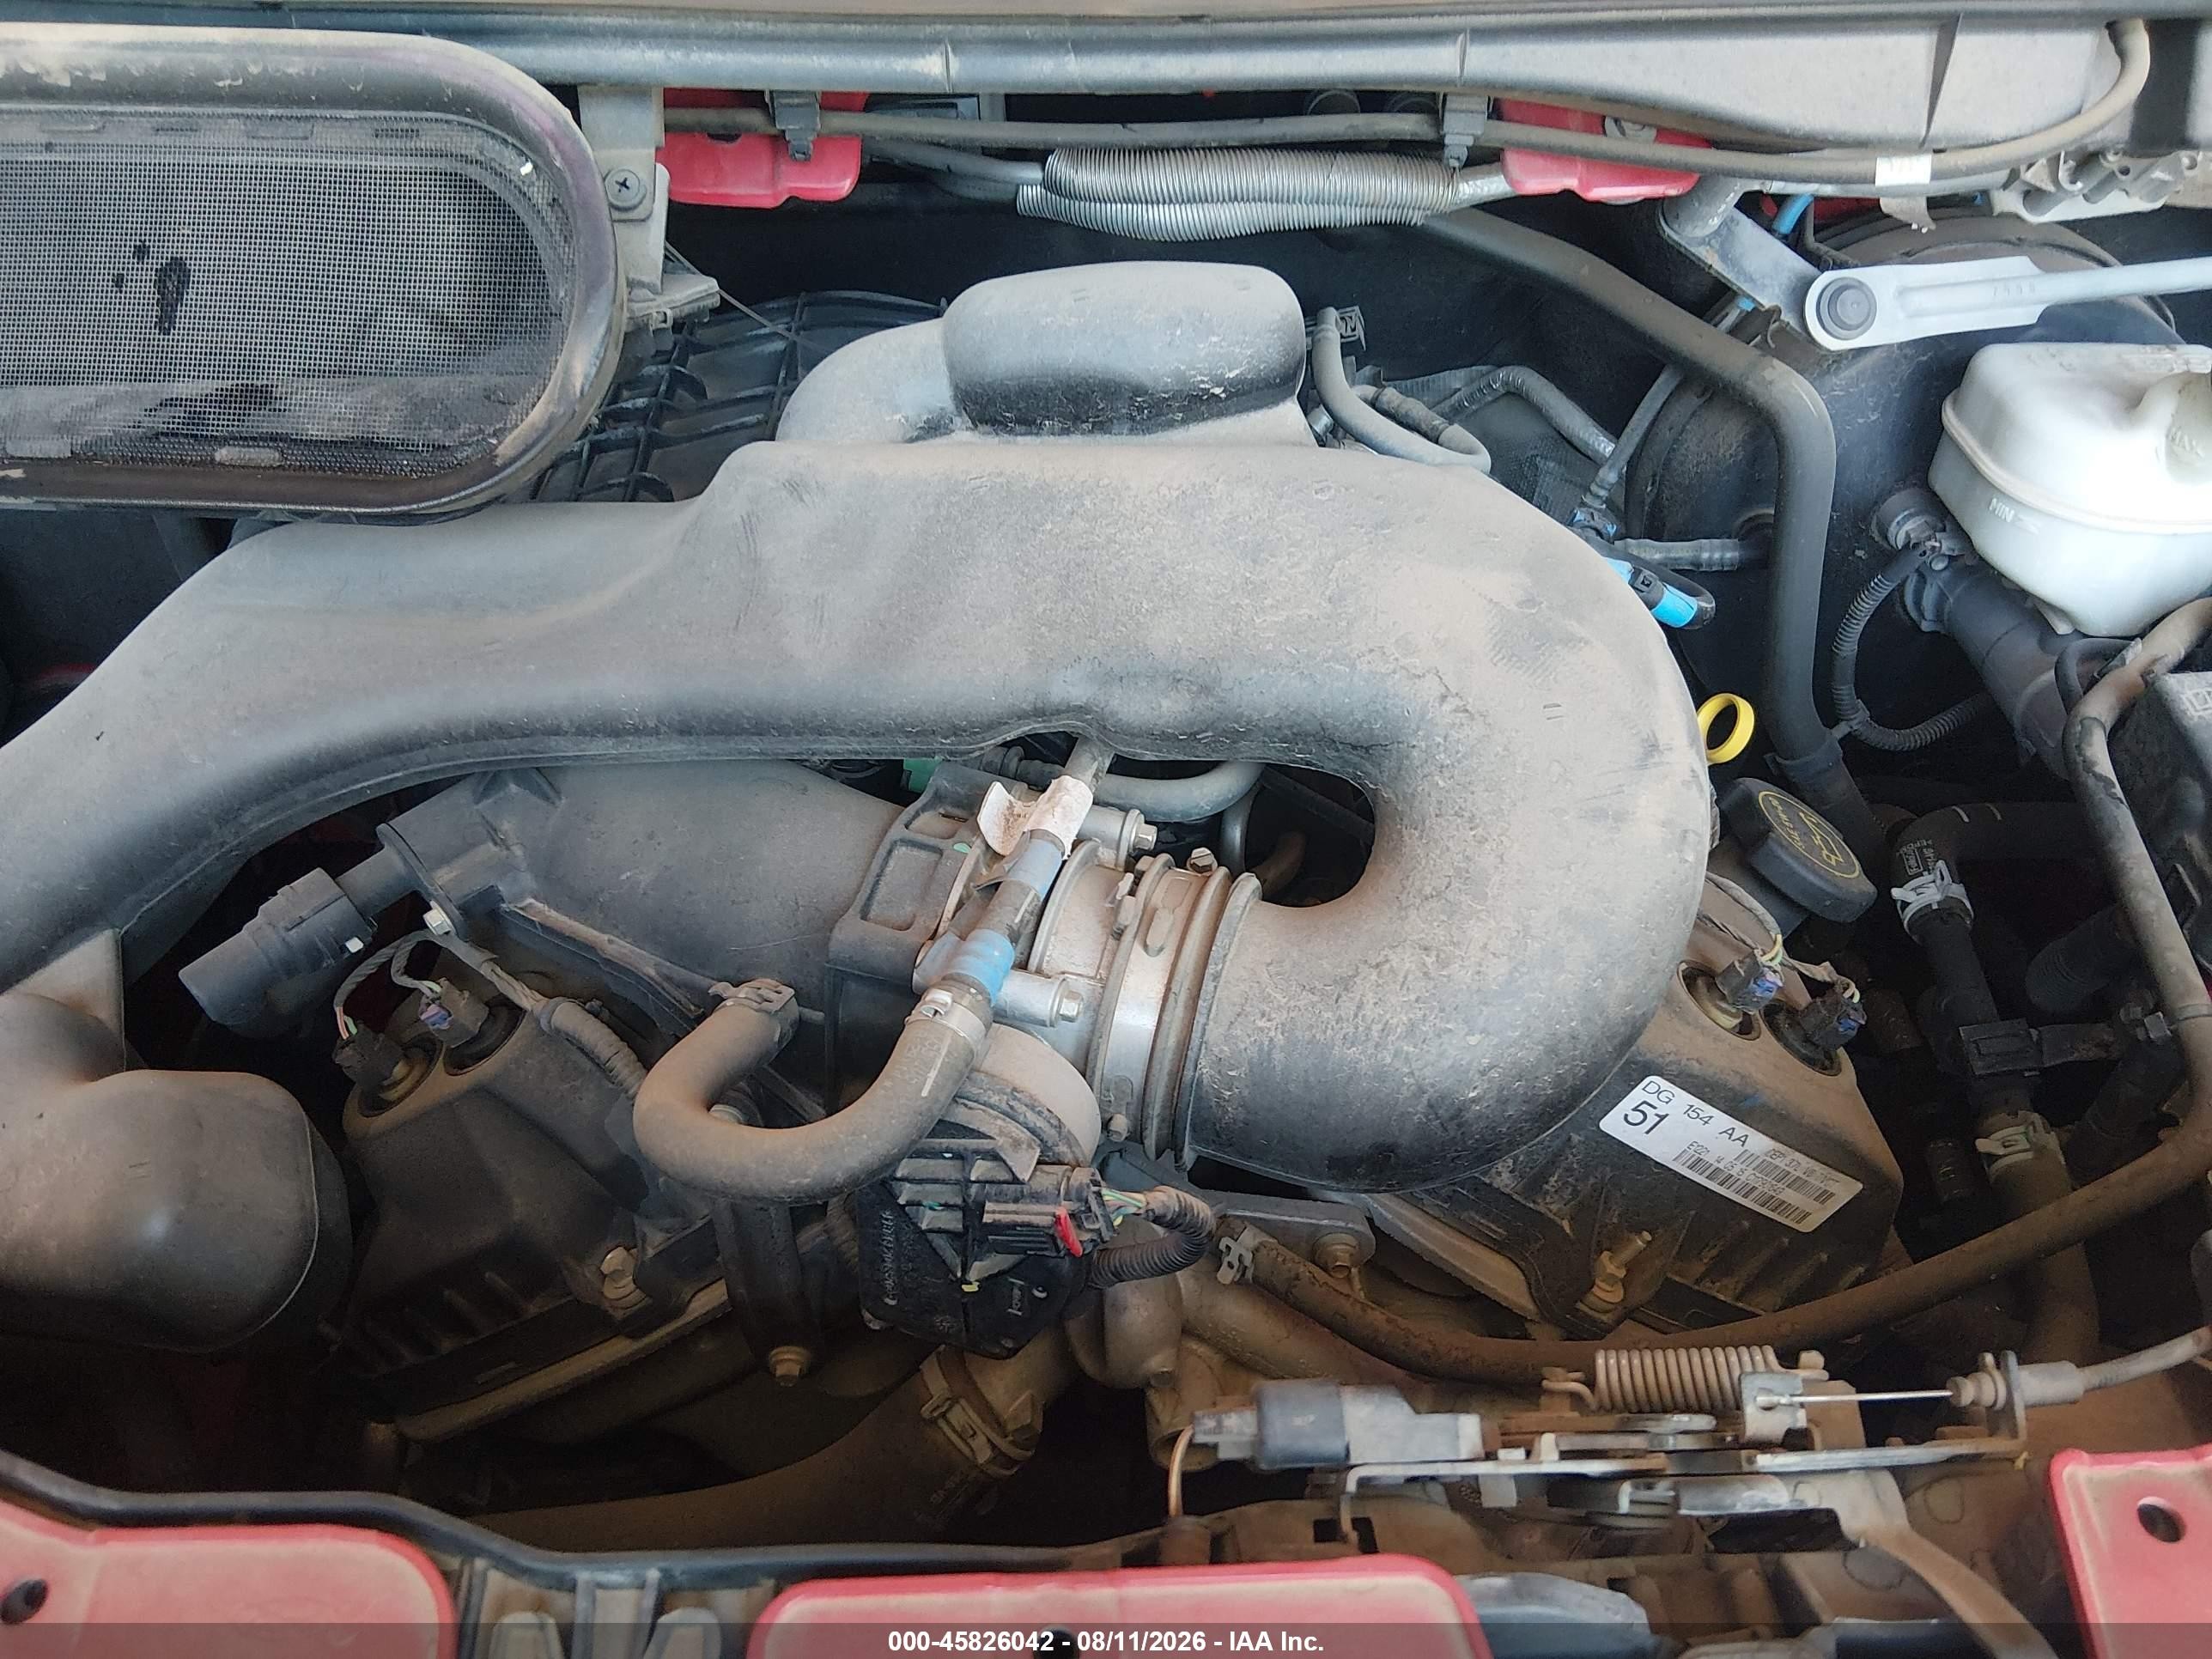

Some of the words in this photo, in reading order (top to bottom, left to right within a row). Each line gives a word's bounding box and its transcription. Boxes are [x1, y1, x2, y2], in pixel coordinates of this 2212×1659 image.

[1988, 497, 2015, 523] MIN
[1623, 1100, 1670, 1135] 51
[1642, 1080, 1675, 1105] DG
[1683, 1104, 1715, 1126] 154
[1718, 1127, 1750, 1148] AA
